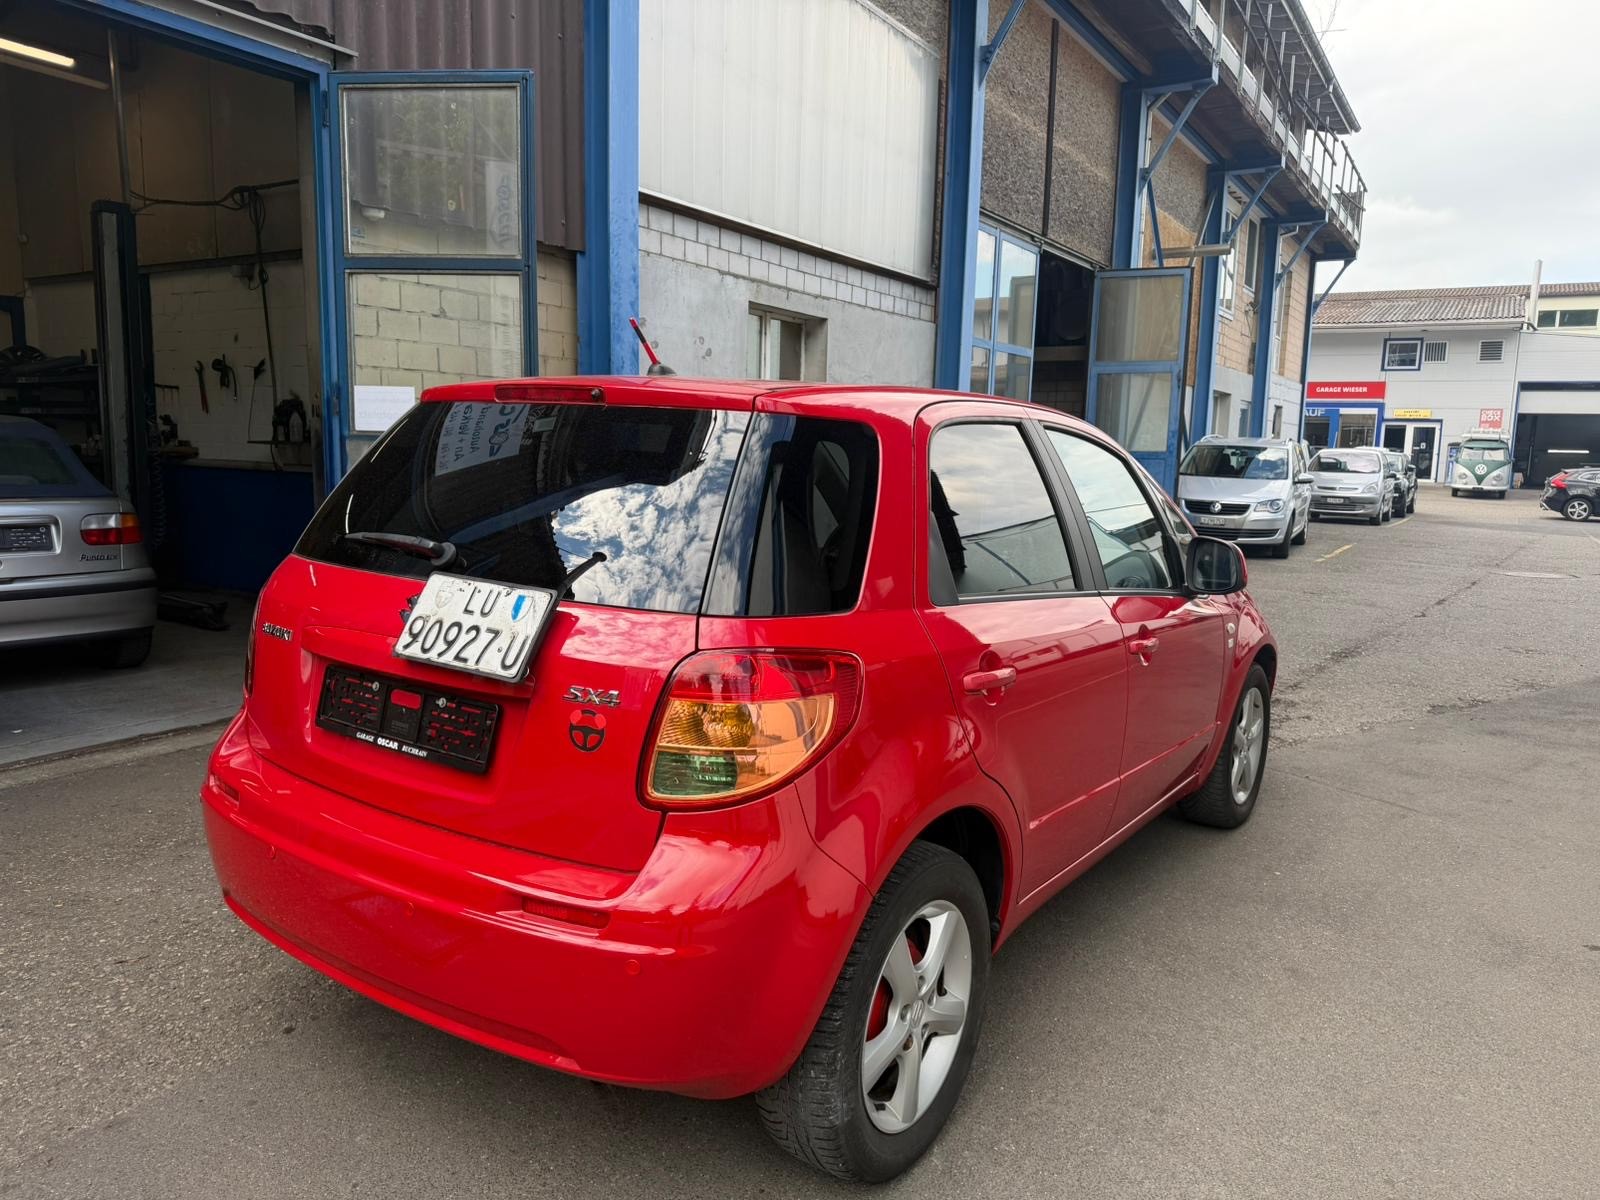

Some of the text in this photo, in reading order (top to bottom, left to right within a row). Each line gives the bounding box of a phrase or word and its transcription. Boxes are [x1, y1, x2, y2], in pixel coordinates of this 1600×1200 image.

[463, 586, 502, 618] LU
[563, 685, 621, 708] SX4
[377, 737, 399, 750] OSCAR
